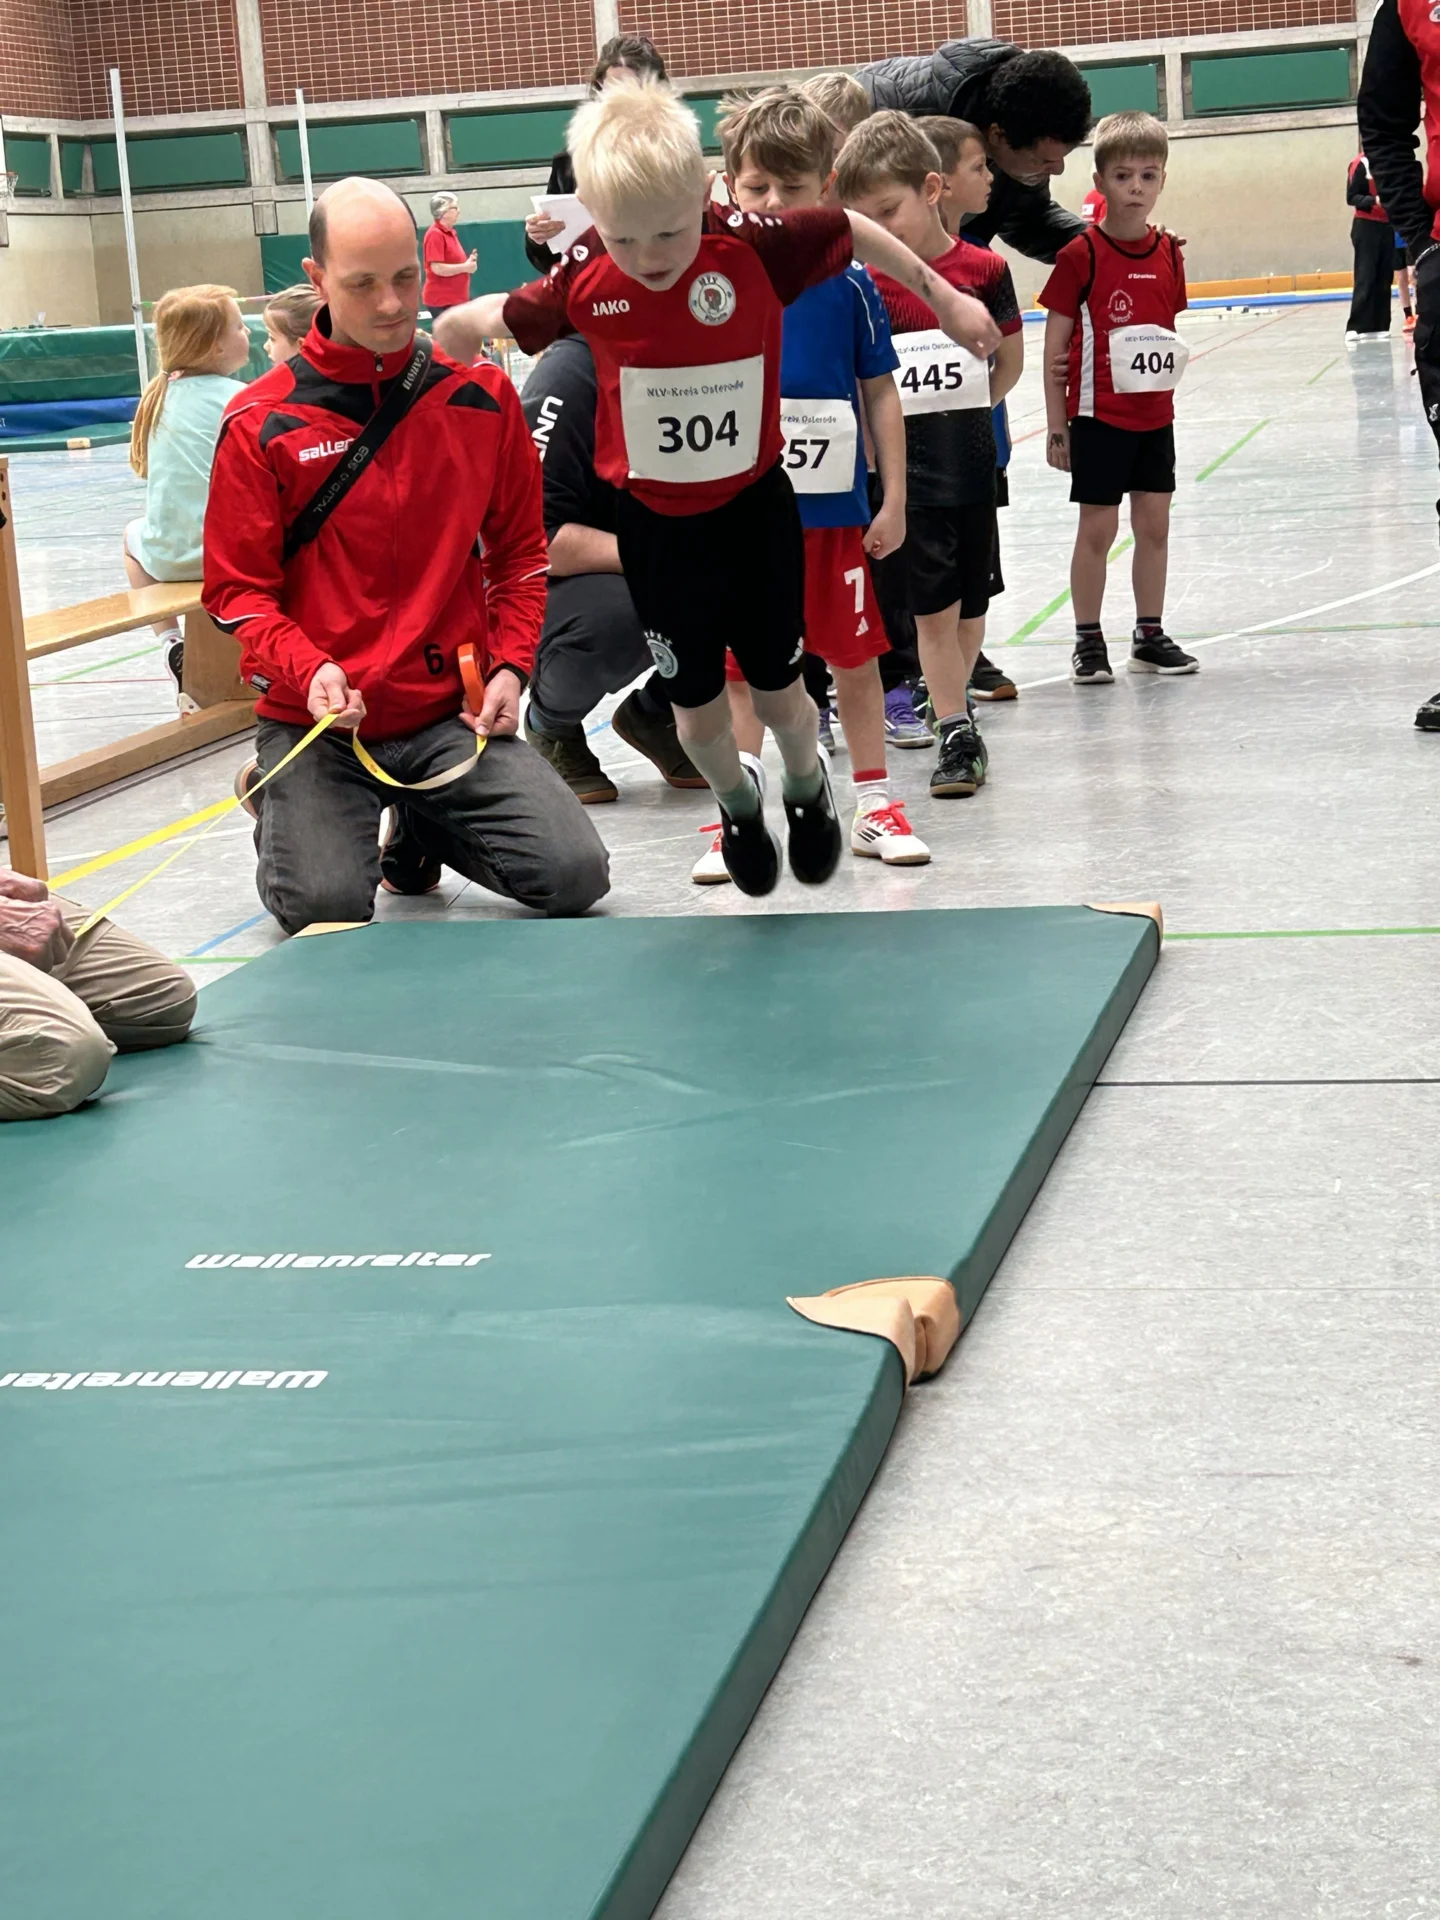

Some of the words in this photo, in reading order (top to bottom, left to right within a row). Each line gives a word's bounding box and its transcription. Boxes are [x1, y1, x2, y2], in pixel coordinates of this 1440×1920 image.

[592, 299, 630, 316] JAKO
[1115, 300, 1127, 311] LG
[402, 349, 426, 390] Canon
[900, 362, 963, 393] 445
[1130, 352, 1175, 374] 404
[657, 409, 739, 453] 304
[299, 438, 355, 462] saller
[348, 445, 370, 471] EOS
[313, 472, 349, 513] DIGITAL
[843, 566, 865, 613] 7
[424, 643, 444, 675] 6
